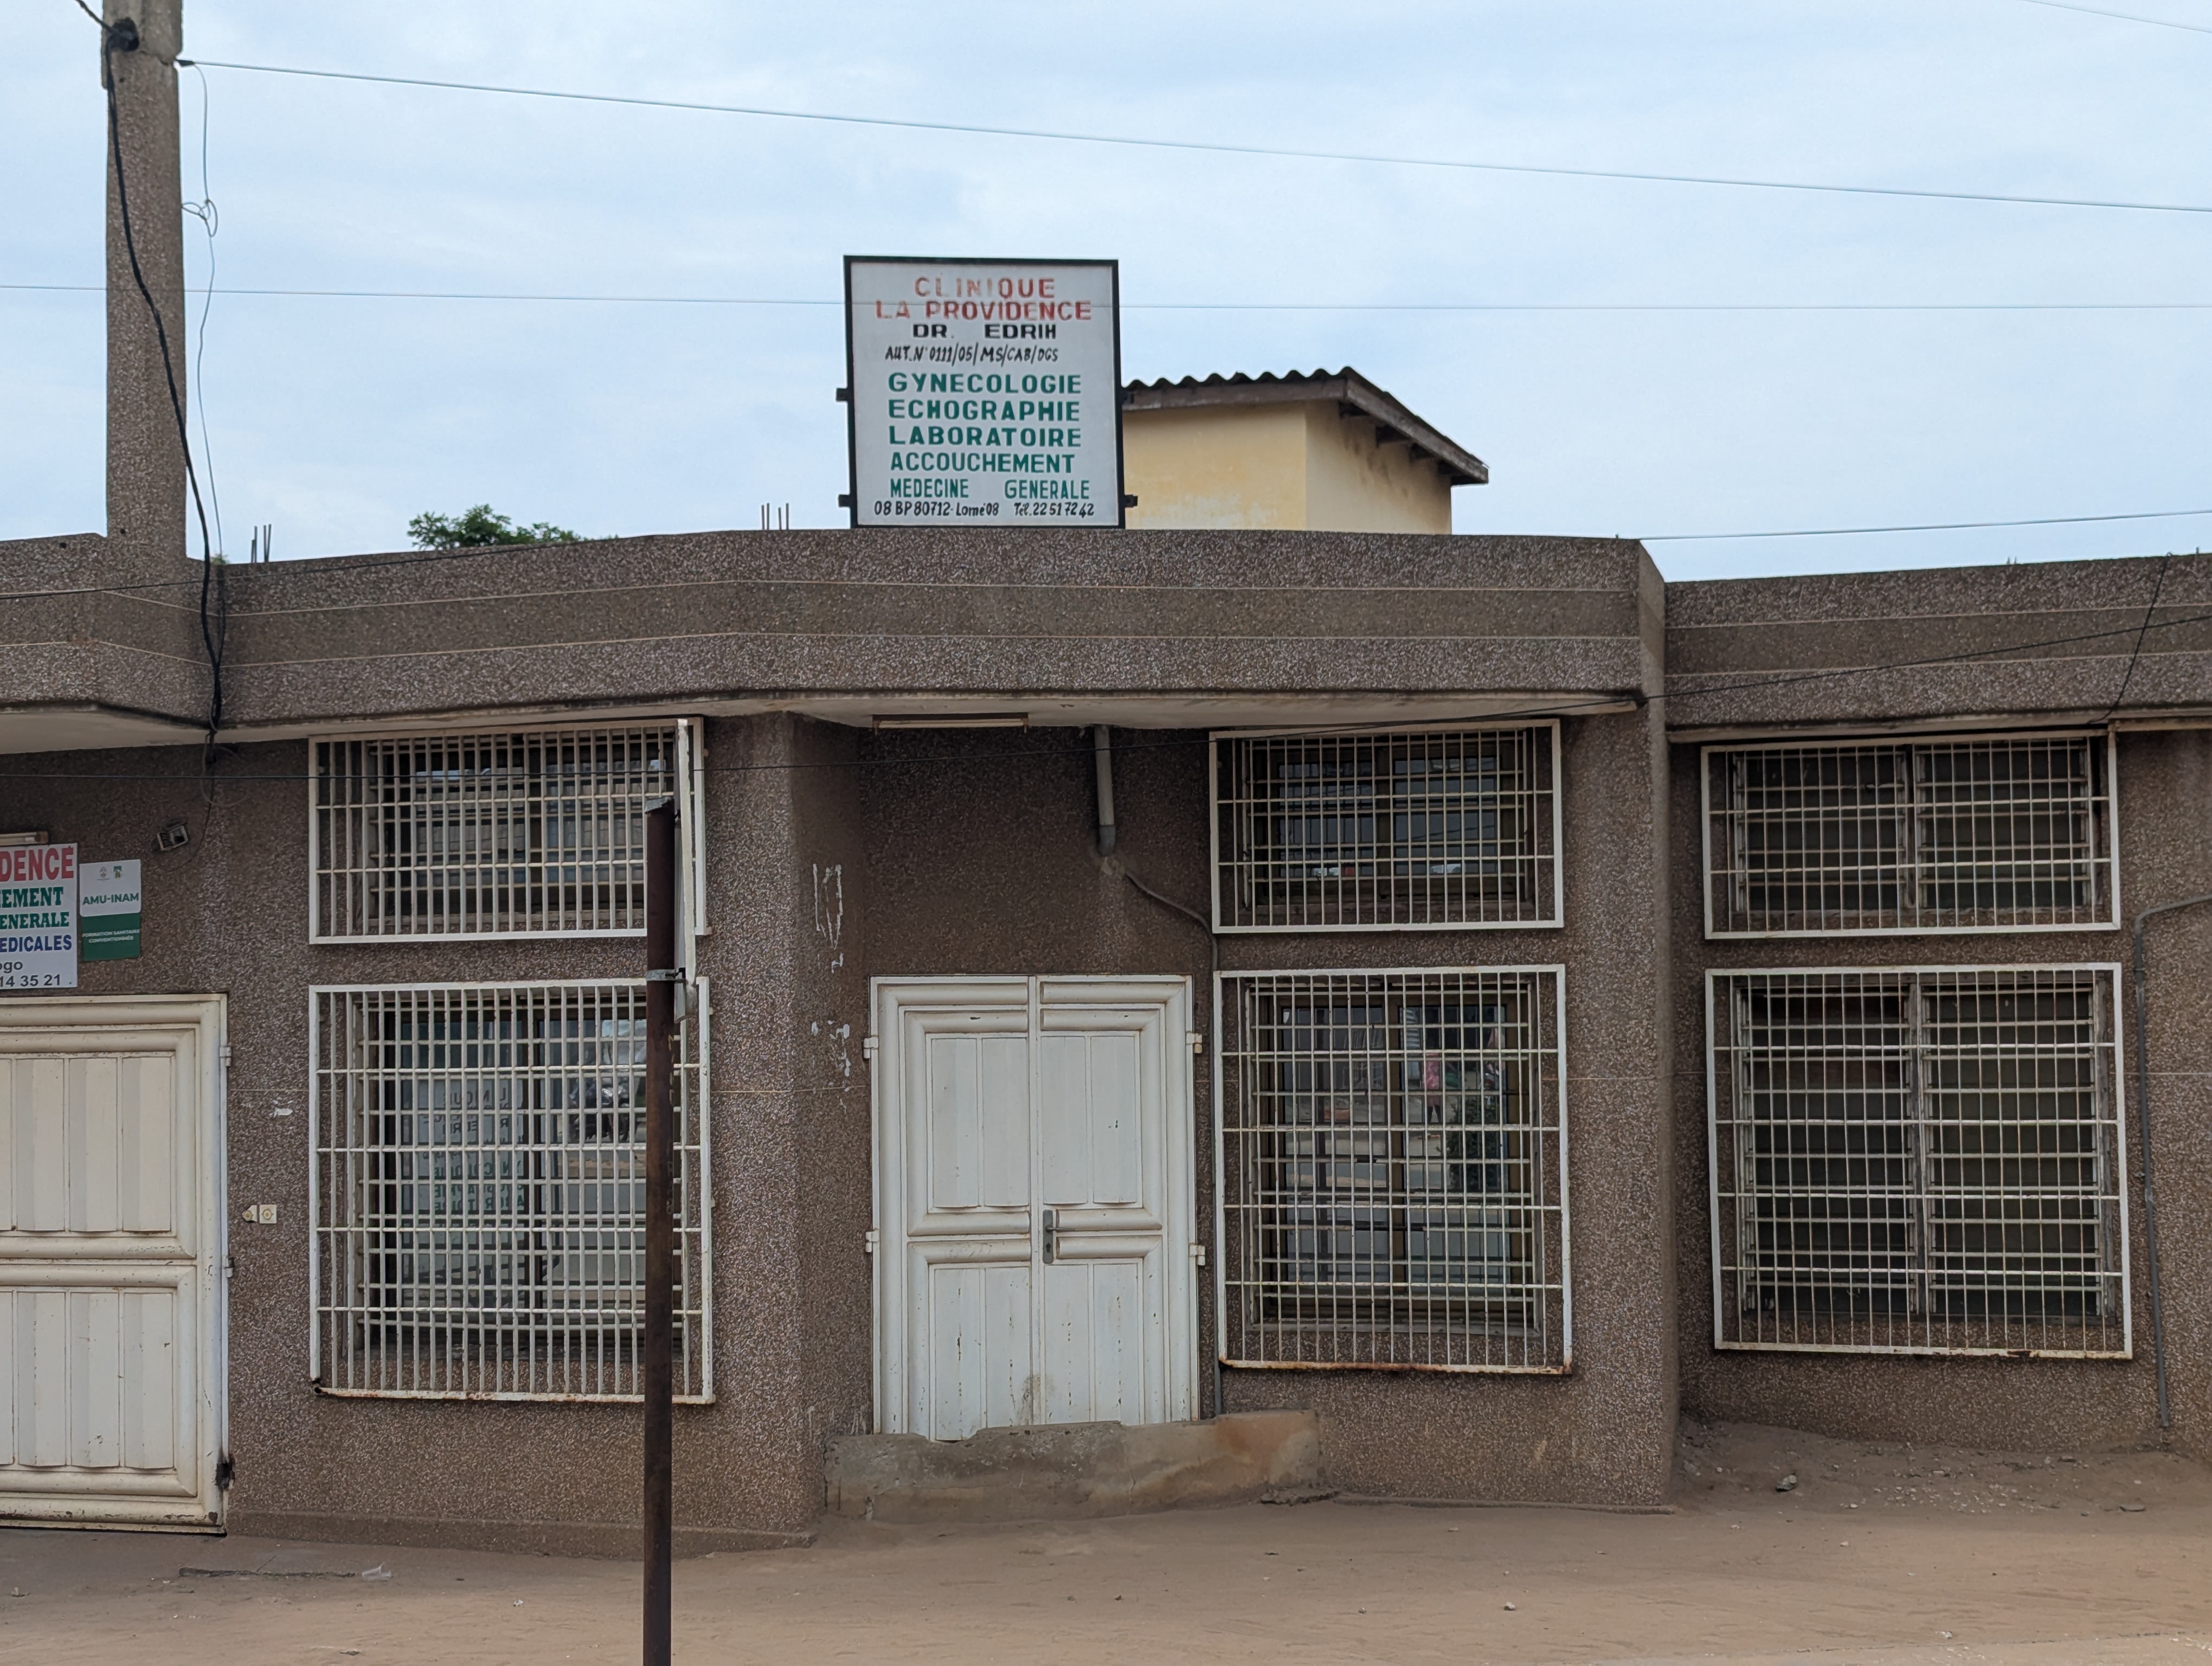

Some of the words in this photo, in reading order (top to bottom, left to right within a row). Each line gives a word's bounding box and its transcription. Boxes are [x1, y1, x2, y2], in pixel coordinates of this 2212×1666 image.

[915, 277, 1055, 299] CLINIQUE
[876, 300, 910, 319] LA
[925, 300, 1091, 321] PROVIDENCE
[985, 324, 1057, 339] EDRIH
[888, 372, 1081, 394] GYNECOLOGIE
[888, 399, 1079, 421] ECHOGRAPHIE
[889, 425, 1081, 447] LABORATOIRE
[890, 451, 1075, 473] ACCOUCHEMENT
[890, 478, 969, 498] MEDECINE
[1005, 479, 1090, 499] GENERALE
[874, 501, 892, 516] 08
[0, 886, 63, 908] EMENT
[82, 893, 139, 905] AMU-INAM
[20, 975, 38, 986] 35
[43, 974, 60, 986] 21
